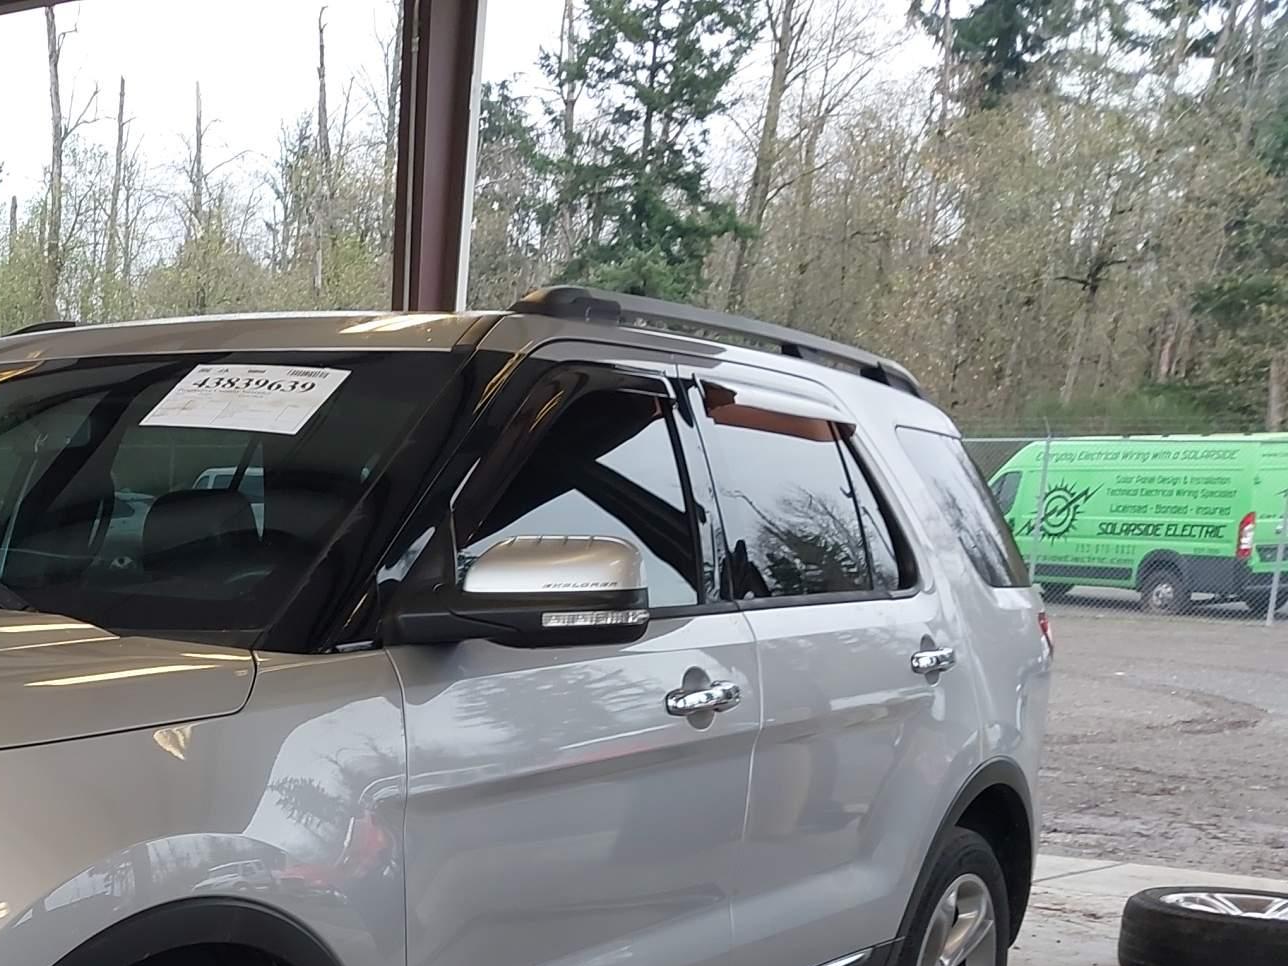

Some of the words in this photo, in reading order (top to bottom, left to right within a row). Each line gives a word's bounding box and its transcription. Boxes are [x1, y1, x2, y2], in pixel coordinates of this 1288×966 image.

[192, 376, 317, 394] 43839639
[1110, 504, 1148, 514] Licensed
[1155, 504, 1189, 515] Bonded
[1096, 522, 1165, 537] SOLARSIDE
[1165, 523, 1228, 539] ELECTRIC
